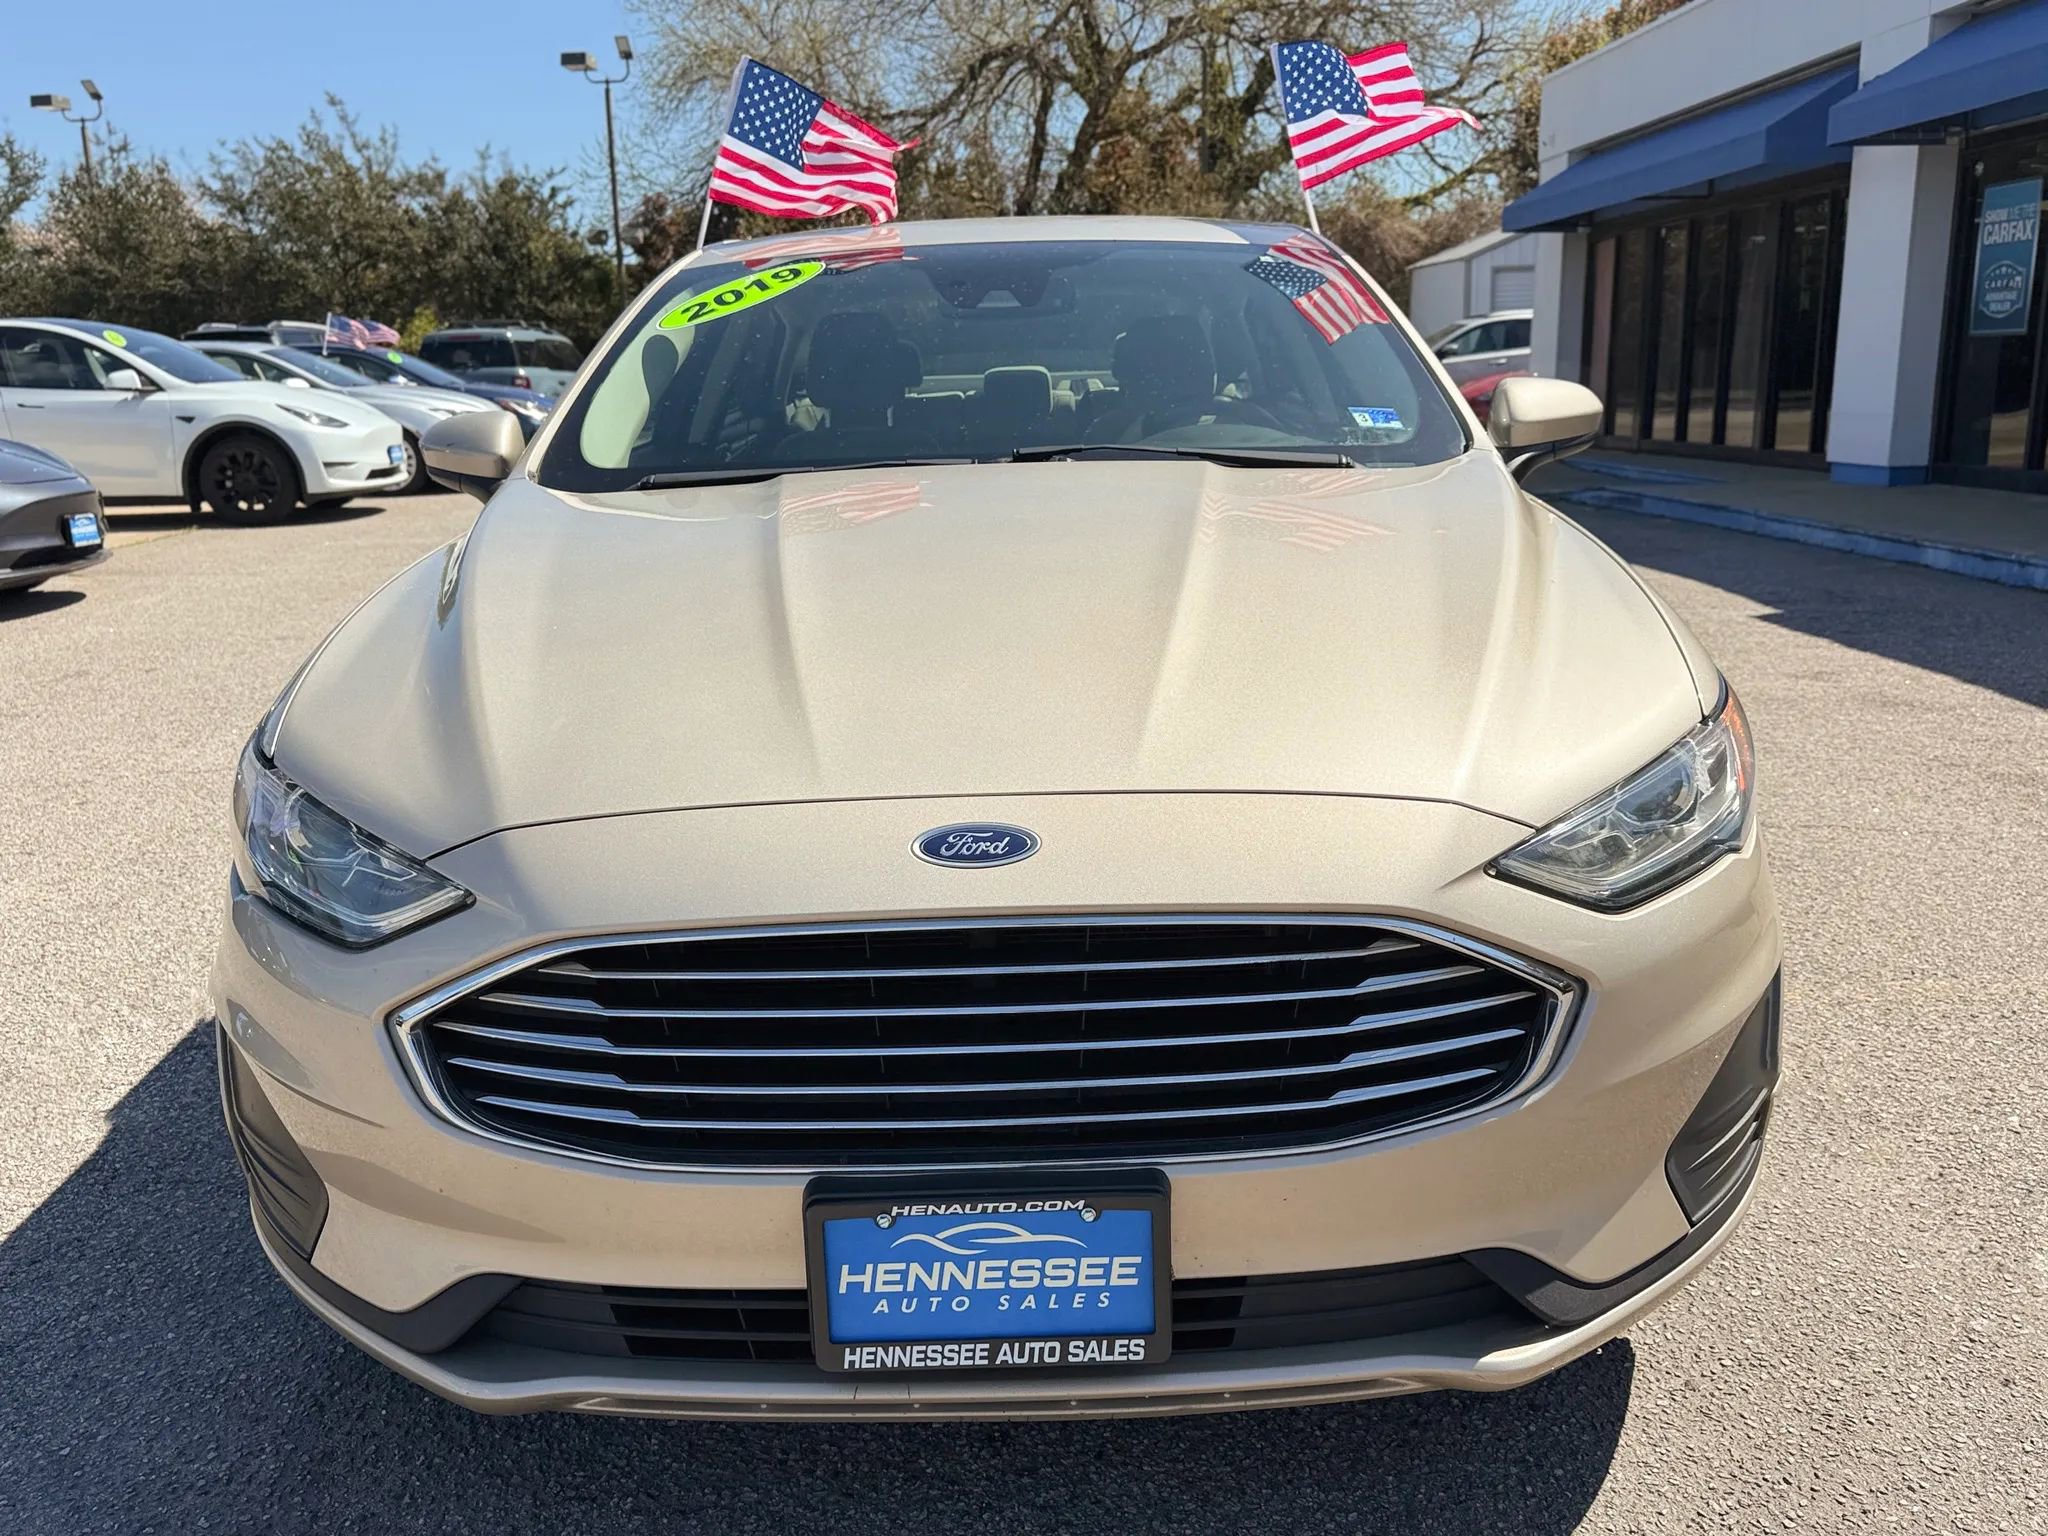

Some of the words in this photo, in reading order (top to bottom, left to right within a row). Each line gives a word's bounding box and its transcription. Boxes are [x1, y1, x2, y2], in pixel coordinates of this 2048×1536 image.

[1984, 208, 2008, 223] SHOW
[1983, 219, 2034, 245] CARFAX
[681, 268, 802, 322] 2019
[940, 832, 1010, 856] Ford
[891, 1200, 1085, 1217] HENAUTO.COM
[838, 1256, 1143, 1294] HENNESSEE
[872, 1296, 971, 1314] AUTO
[997, 1292, 1112, 1311] SALES
[843, 1343, 990, 1369] HENNESSEE
[995, 1341, 1060, 1365] AUTO
[1067, 1339, 1146, 1362] SALES
